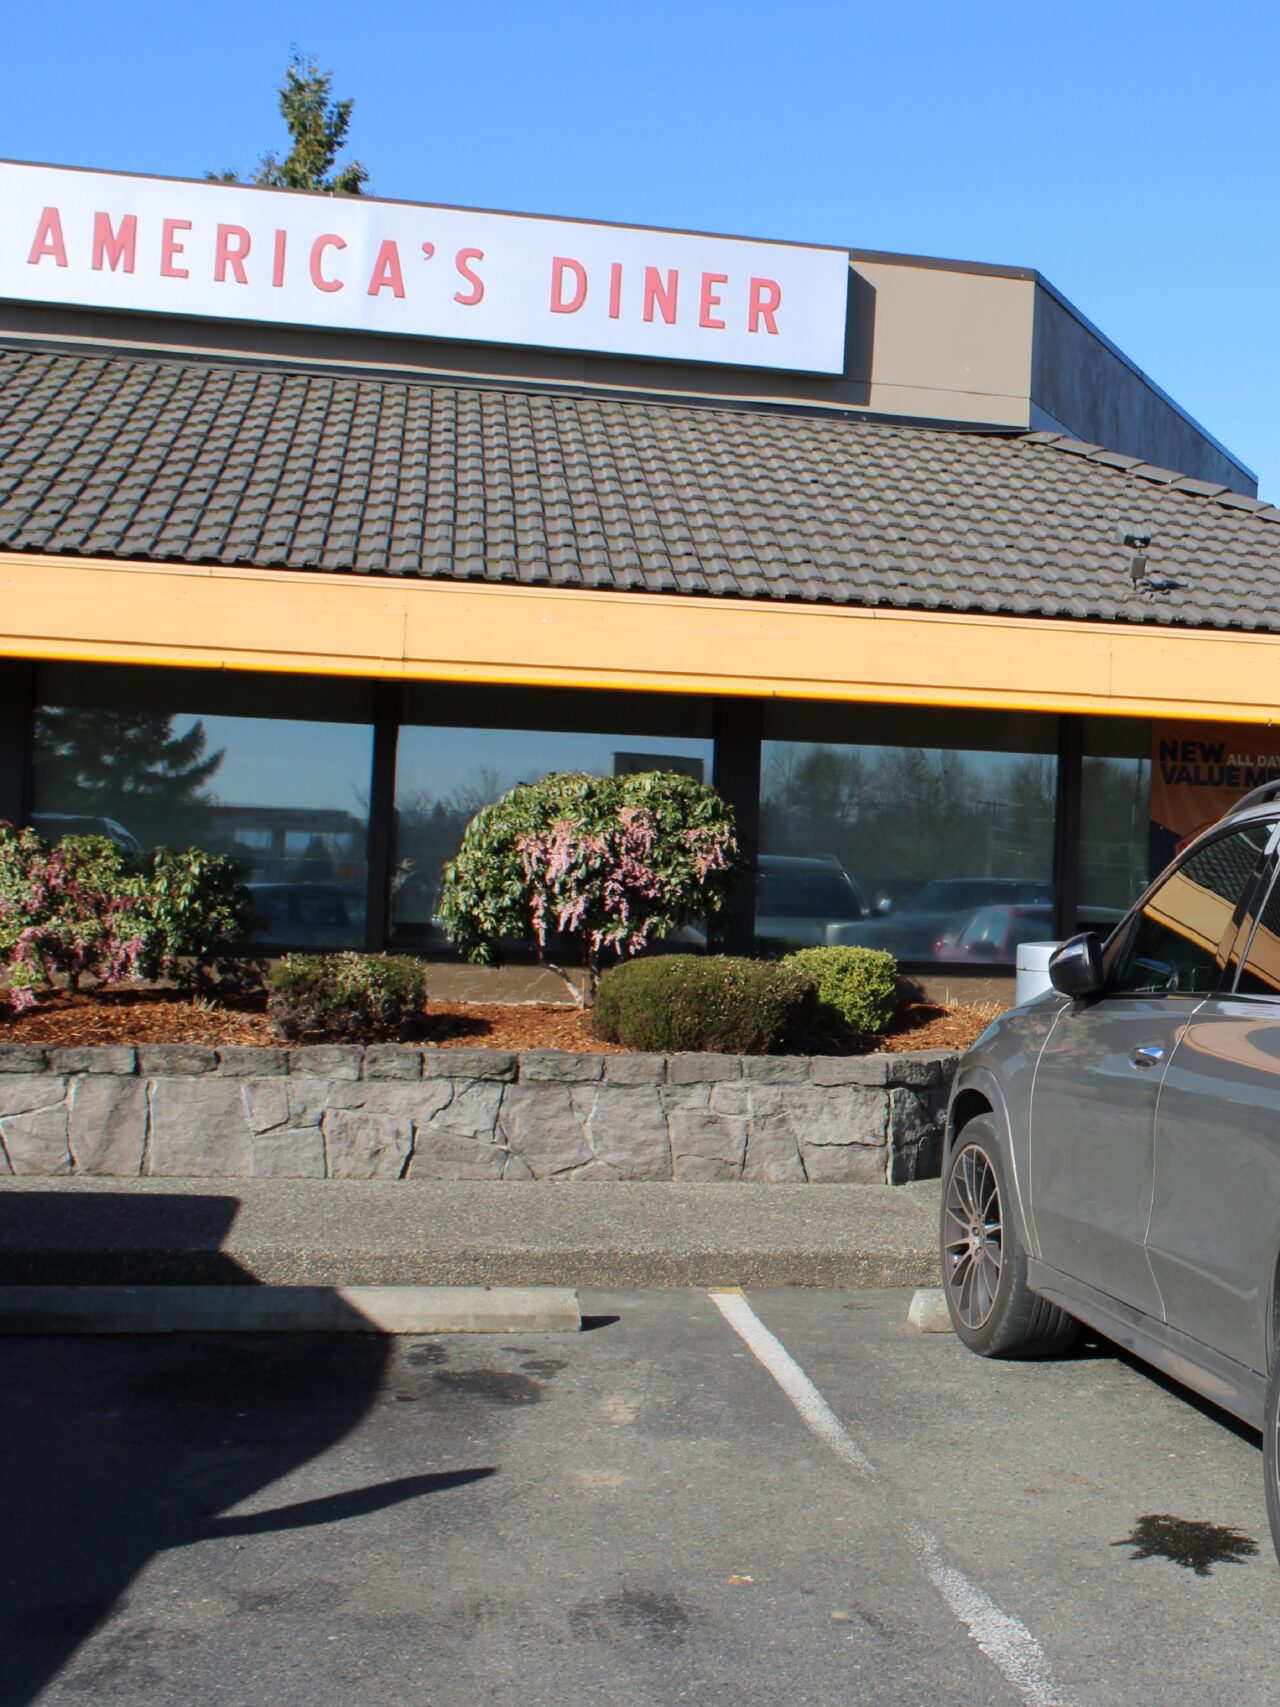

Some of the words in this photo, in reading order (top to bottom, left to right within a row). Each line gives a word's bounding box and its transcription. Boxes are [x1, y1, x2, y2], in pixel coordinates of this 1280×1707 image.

[27, 206, 485, 306] AMERICA'S
[550, 256, 782, 335] DINER
[1159, 739, 1227, 764] NEW
[1226, 754, 1254, 767] ALL
[1159, 764, 1240, 788] VALUE
